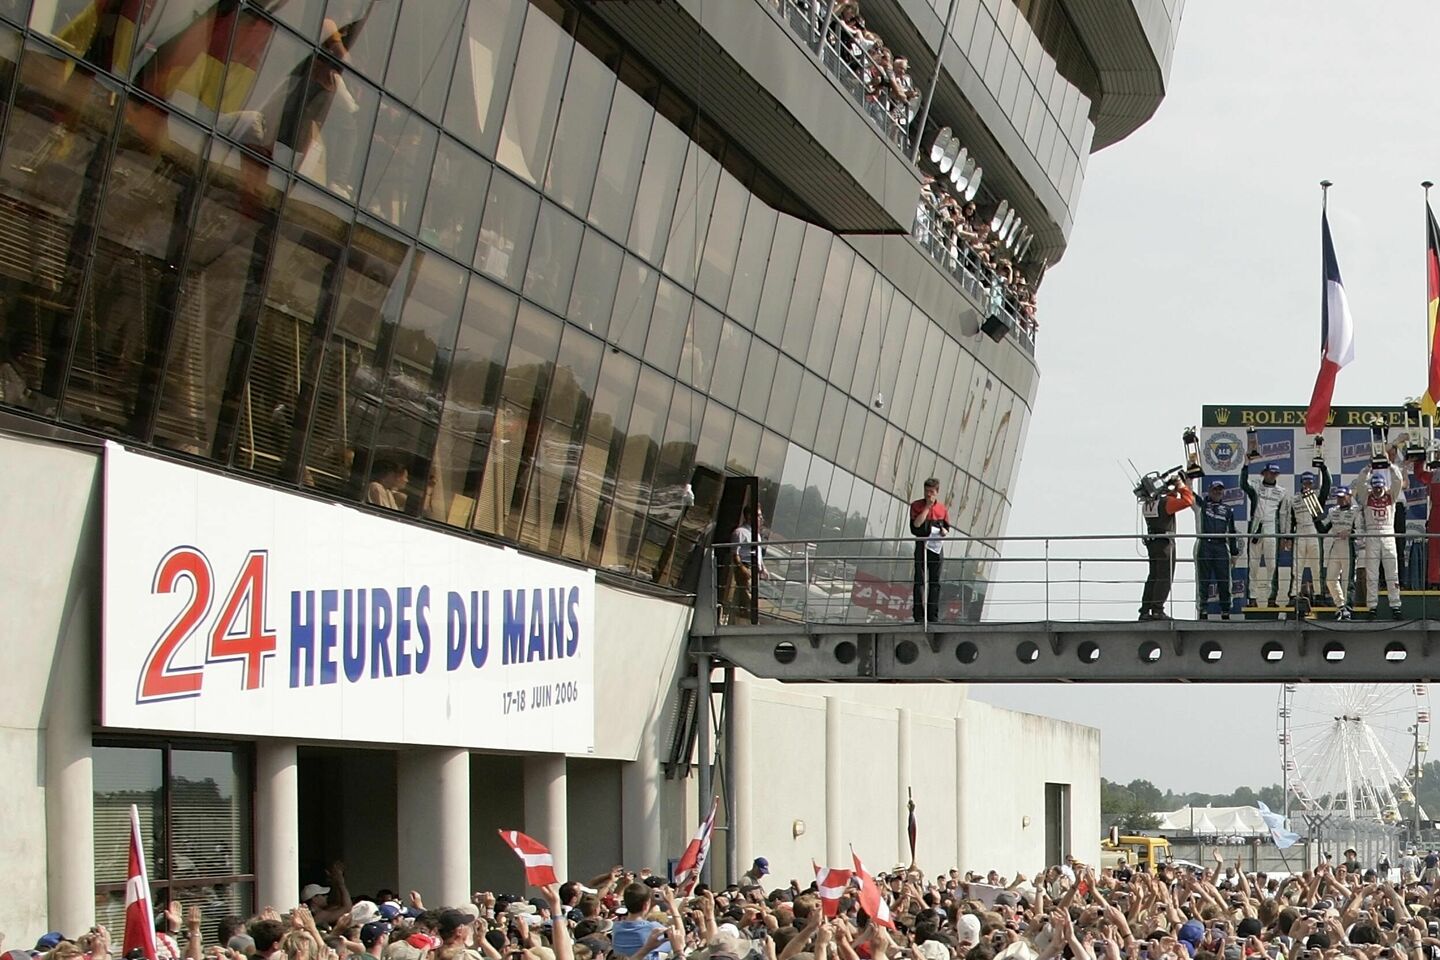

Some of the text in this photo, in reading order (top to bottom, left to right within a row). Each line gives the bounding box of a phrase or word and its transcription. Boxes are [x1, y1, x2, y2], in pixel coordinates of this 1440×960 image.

[1241, 410, 1307, 425] ROLEX
[136, 545, 581, 705] 24 HEURES DU MANS
[503, 681, 578, 715] 17-18 JUIN 2006
